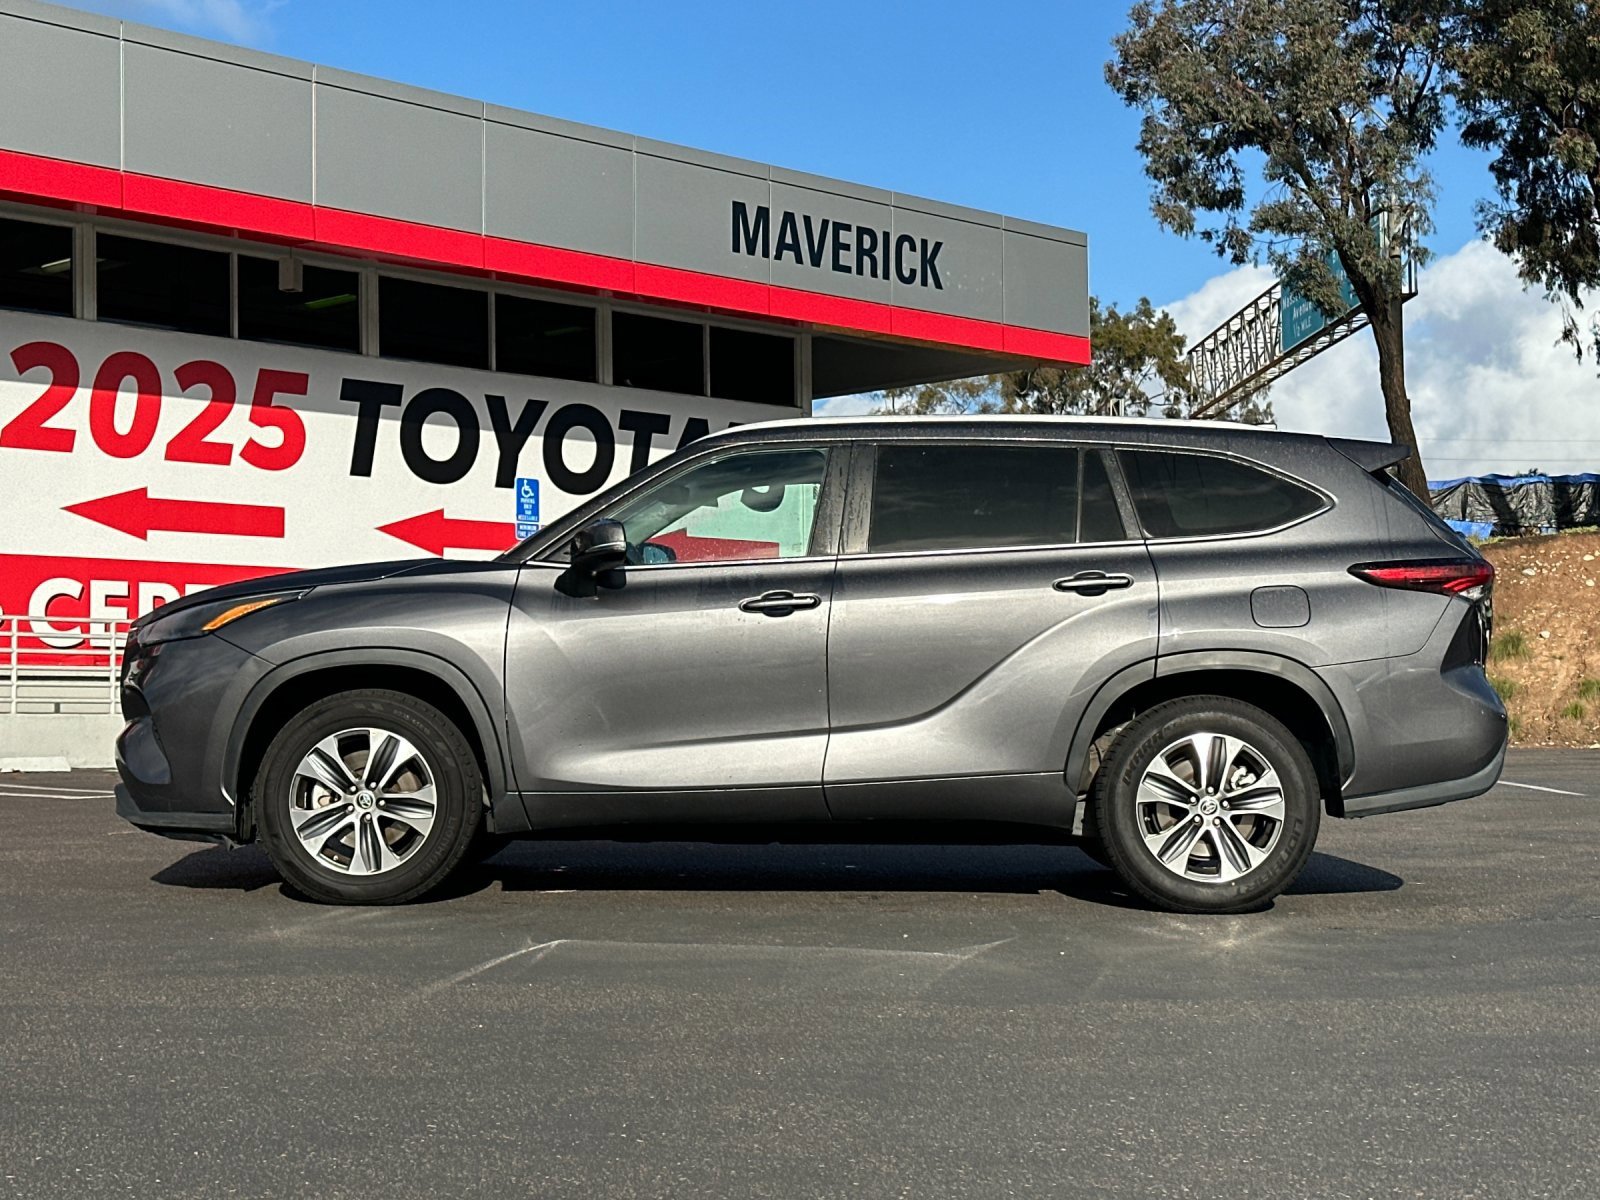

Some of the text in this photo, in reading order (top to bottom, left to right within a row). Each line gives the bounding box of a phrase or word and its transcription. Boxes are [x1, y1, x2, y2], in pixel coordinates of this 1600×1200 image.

[732, 200, 943, 290] MAVERICK
[0, 341, 309, 471] 2025
[28, 577, 218, 648] CE
